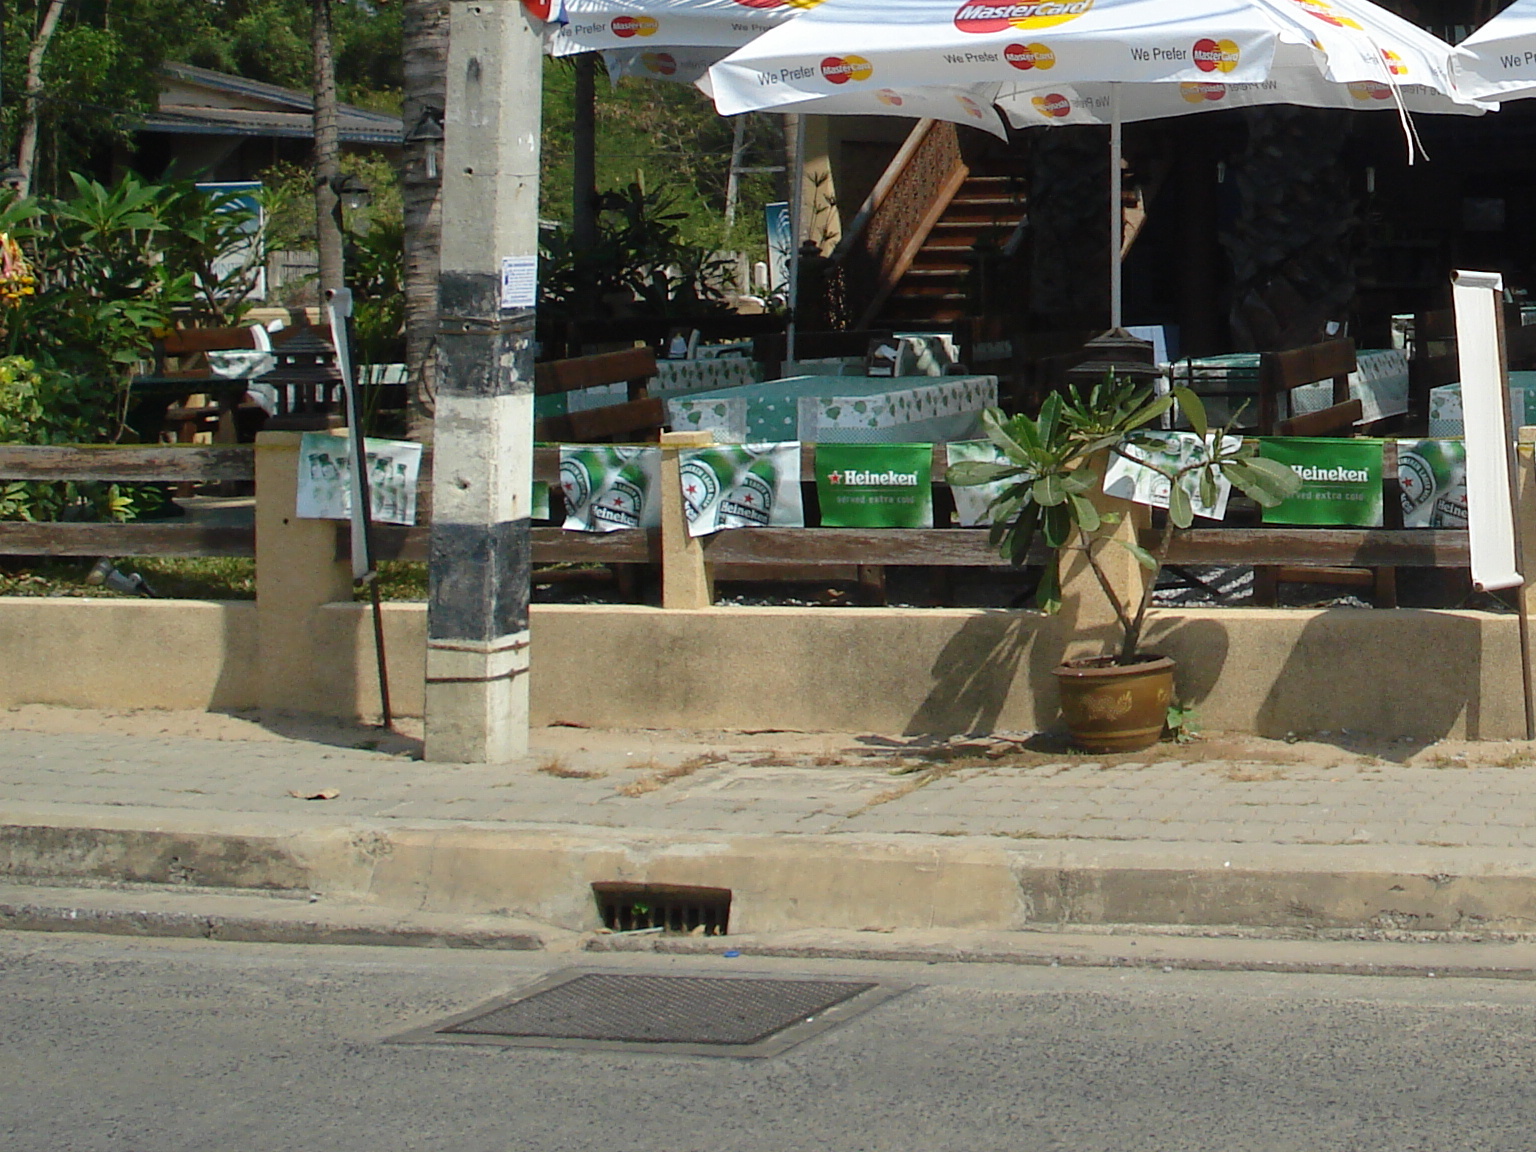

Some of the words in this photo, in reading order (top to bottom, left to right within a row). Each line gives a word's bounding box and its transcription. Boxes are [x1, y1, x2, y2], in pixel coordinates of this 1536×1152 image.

[575, 22, 606, 36] Prefer
[731, 23, 748, 31] We
[943, 54, 965, 64] We
[967, 51, 999, 63] Prefer
[1130, 48, 1150, 61] We
[1153, 47, 1187, 61] Prefer
[1194, 49, 1239, 62] MasterCard
[1500, 55, 1521, 69] We
[758, 71, 778, 86] We
[780, 65, 815, 82] Prefer
[822, 63, 872, 77] MasterCard
[843, 470, 918, 486] Heineken
[1291, 465, 1368, 482] Heineken
